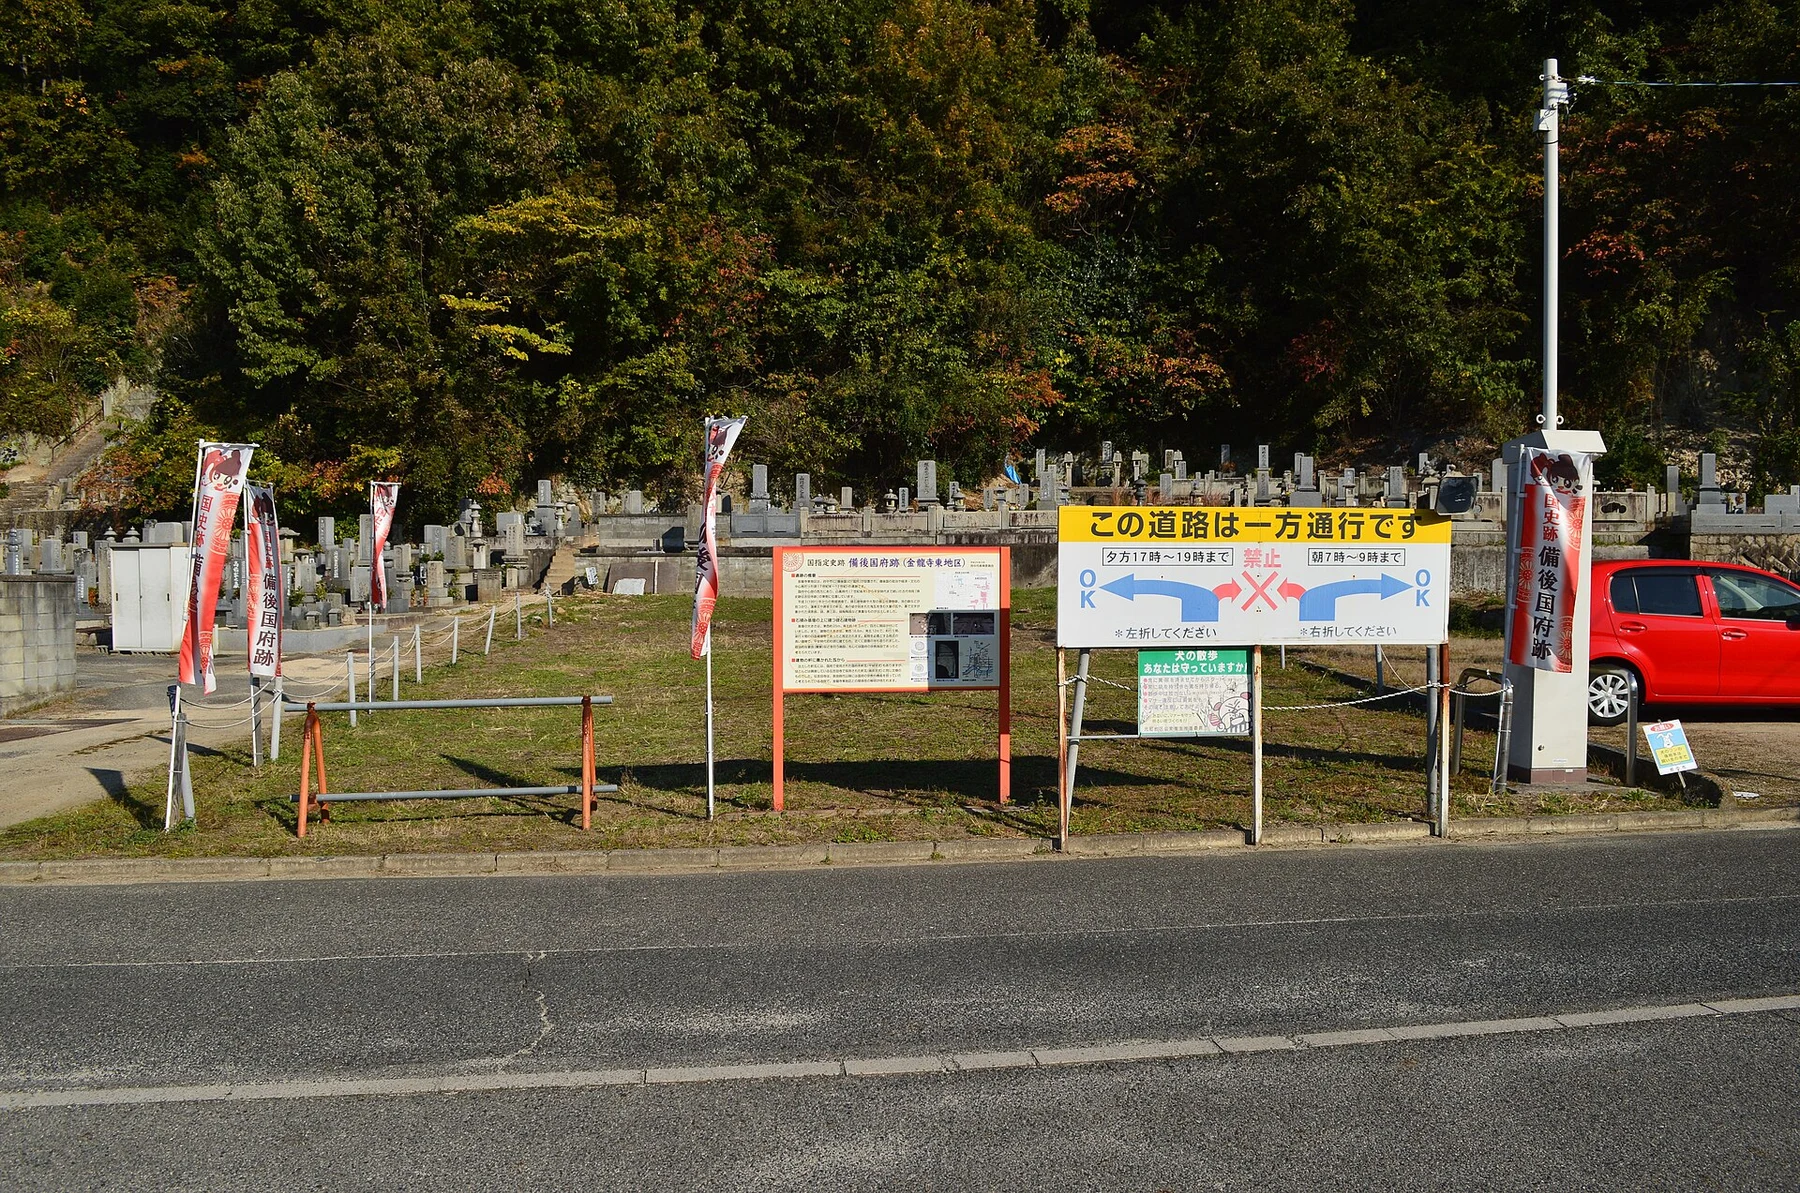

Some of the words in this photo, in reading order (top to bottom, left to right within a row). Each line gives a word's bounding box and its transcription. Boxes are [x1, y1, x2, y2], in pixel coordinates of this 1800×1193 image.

[196, 494, 214, 548] 国史跡
[1091, 510, 1422, 540] この道路は一方通行です
[1542, 493, 1560, 542] 国史跡
[807, 559, 845, 567] 国指定史跡
[1243, 548, 1282, 568] 禁止
[253, 573, 279, 667] 備後国府跡
[1531, 545, 1561, 660] 備後国府跡
[1175, 650, 1218, 661] 犬の散歩
